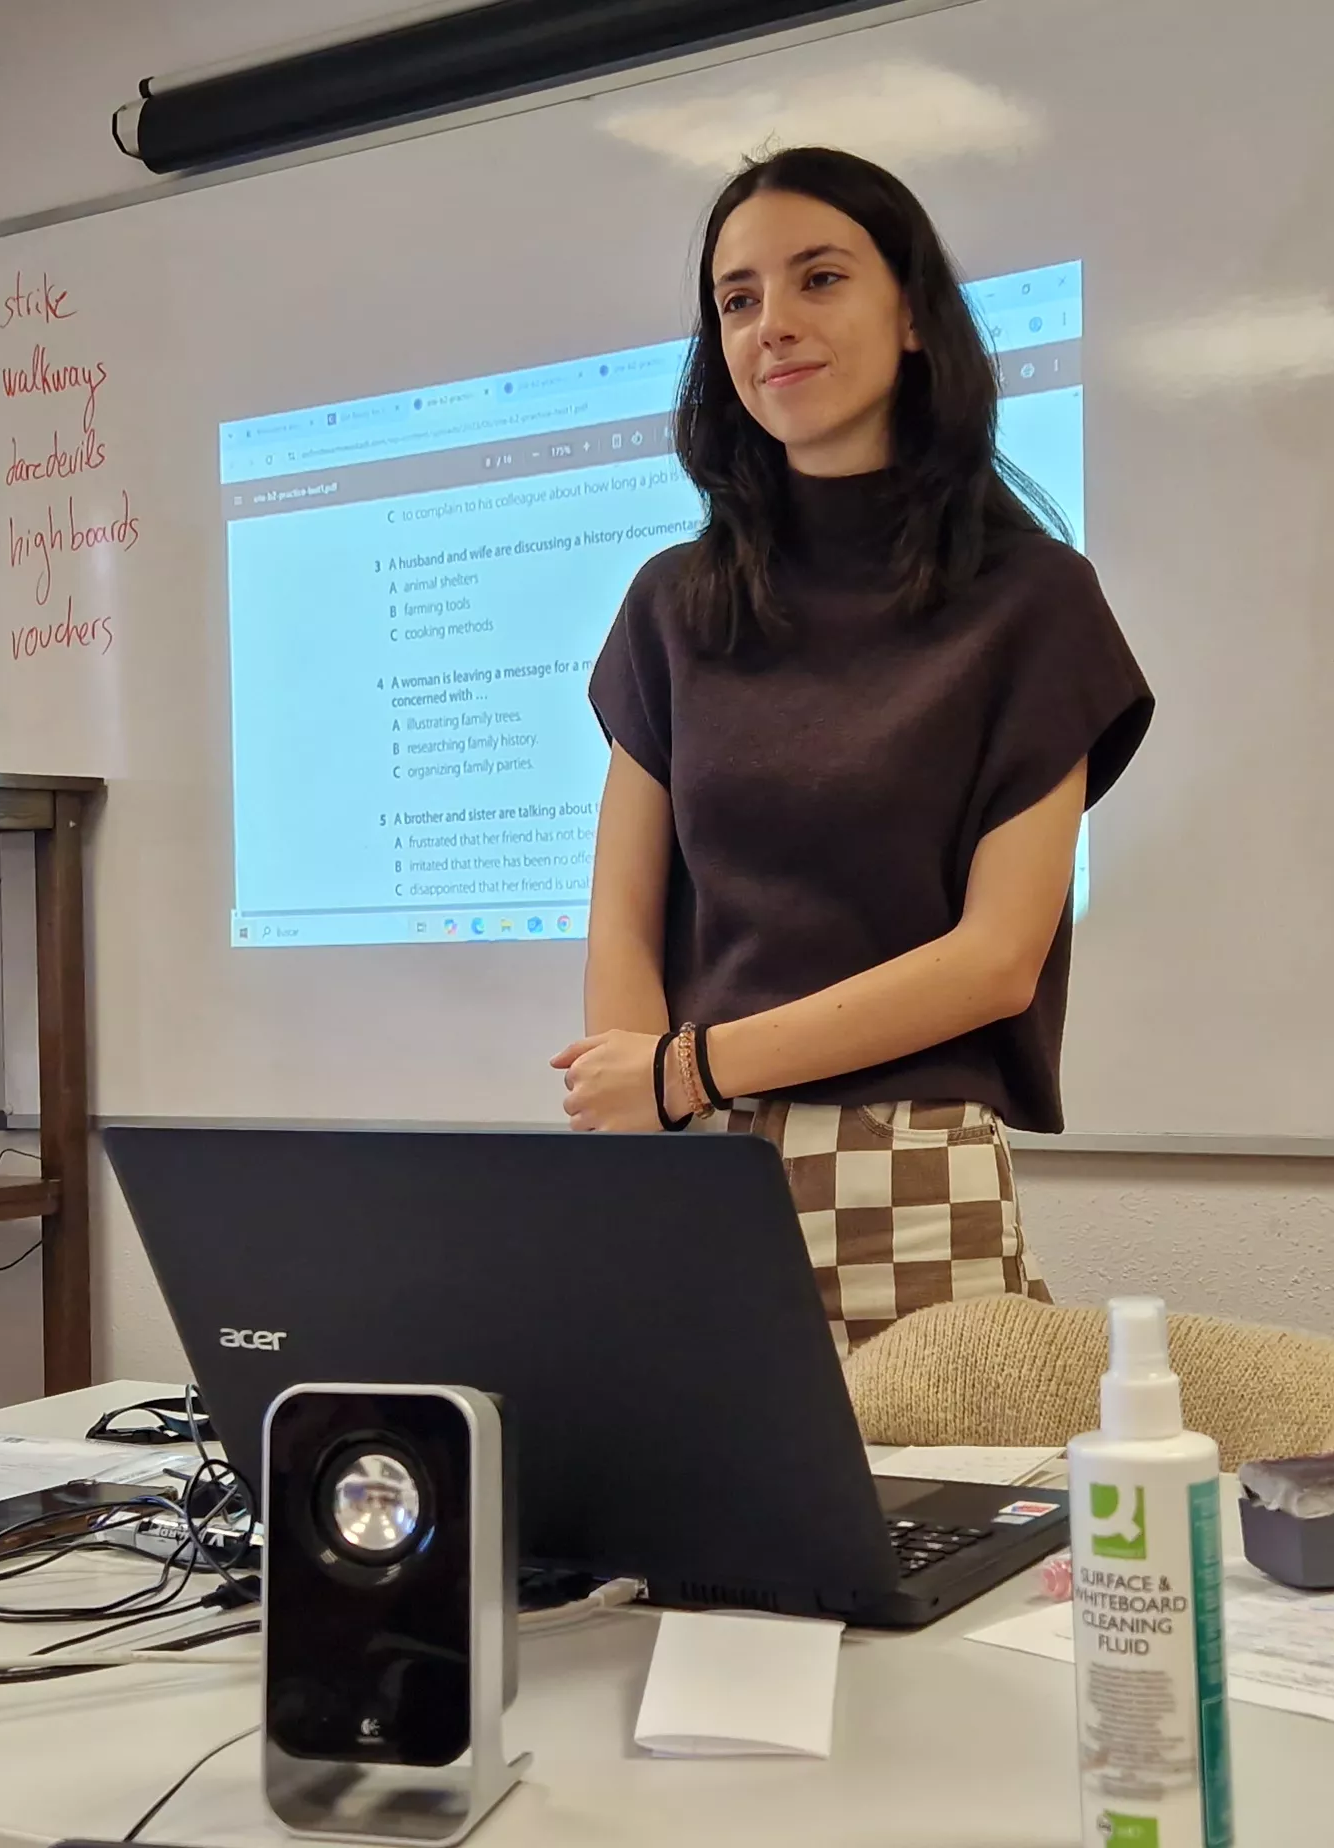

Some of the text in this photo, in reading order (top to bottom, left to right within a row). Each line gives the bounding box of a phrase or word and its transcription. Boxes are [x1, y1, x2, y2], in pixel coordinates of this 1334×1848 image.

[0, 271, 78, 329] strike
[2, 344, 107, 433] walkways
[5, 428, 106, 486] daredevils
[387, 510, 395, 523] C
[403, 511, 413, 522] to
[415, 503, 463, 519] complain
[465, 501, 475, 511] to
[478, 498, 493, 510] his
[496, 490, 547, 508] colleague
[549, 485, 581, 500] about
[584, 481, 609, 494] how
[611, 476, 637, 490] long
[640, 475, 646, 486] a
[648, 471, 667, 488] job
[375, 519, 701, 573] 3 A husband and wife are discussing a history documentar
[389, 572, 479, 594] A animal shelters
[390, 597, 471, 618] B farming tools
[11, 595, 113, 660] vouchers
[390, 618, 494, 641] C cooking methods
[376, 678, 384, 690] 4
[391, 676, 400, 690] A
[401, 674, 441, 688] woman
[442, 672, 451, 685] is
[453, 668, 492, 684] leaving
[495, 670, 502, 680] a
[503, 665, 552, 679] message
[555, 659, 569, 673] for
[573, 661, 579, 671] a
[392, 690, 447, 708] concerned
[449, 688, 473, 703] with
[392, 719, 400, 732] A
[407, 712, 459, 731] illustrating
[461, 710, 492, 727] family
[393, 732, 539, 755] B researching family history.
[393, 756, 534, 780] C organizing family parties.
[379, 814, 386, 826] 5
[394, 812, 402, 825] A
[404, 810, 443, 825] brother
[445, 808, 466, 823] and
[468, 808, 496, 822] sister
[498, 807, 516, 819] are
[518, 803, 556, 820] talking
[559, 802, 592, 816] about
[395, 837, 402, 849] A
[409, 832, 457, 849] frustrated
[460, 831, 480, 846] that
[483, 830, 499, 844] her
[502, 828, 533, 843] friend
[535, 827, 554, 842] has
[556, 828, 575, 841] not
[395, 861, 402, 873] B
[410, 857, 448, 872] irritated
[451, 856, 471, 870] that
[474, 854, 501, 869] there
[503, 853, 521, 868] has
[524, 850, 551, 866] been
[554, 853, 568, 866] no
[395, 884, 402, 896] C
[410, 879, 475, 897] disappointed
[478, 879, 499, 893] that
[502, 877, 518, 892] her
[521, 875, 553, 891] friend
[555, 876, 563, 890] is
[219, 1327, 287, 1351] acer
[1080, 1566, 1173, 1592] SURFACE &
[1074, 1584, 1188, 1613] WHITEBOARD
[1082, 1609, 1173, 1635] CLEANING
[1098, 1633, 1150, 1655] FLUID
